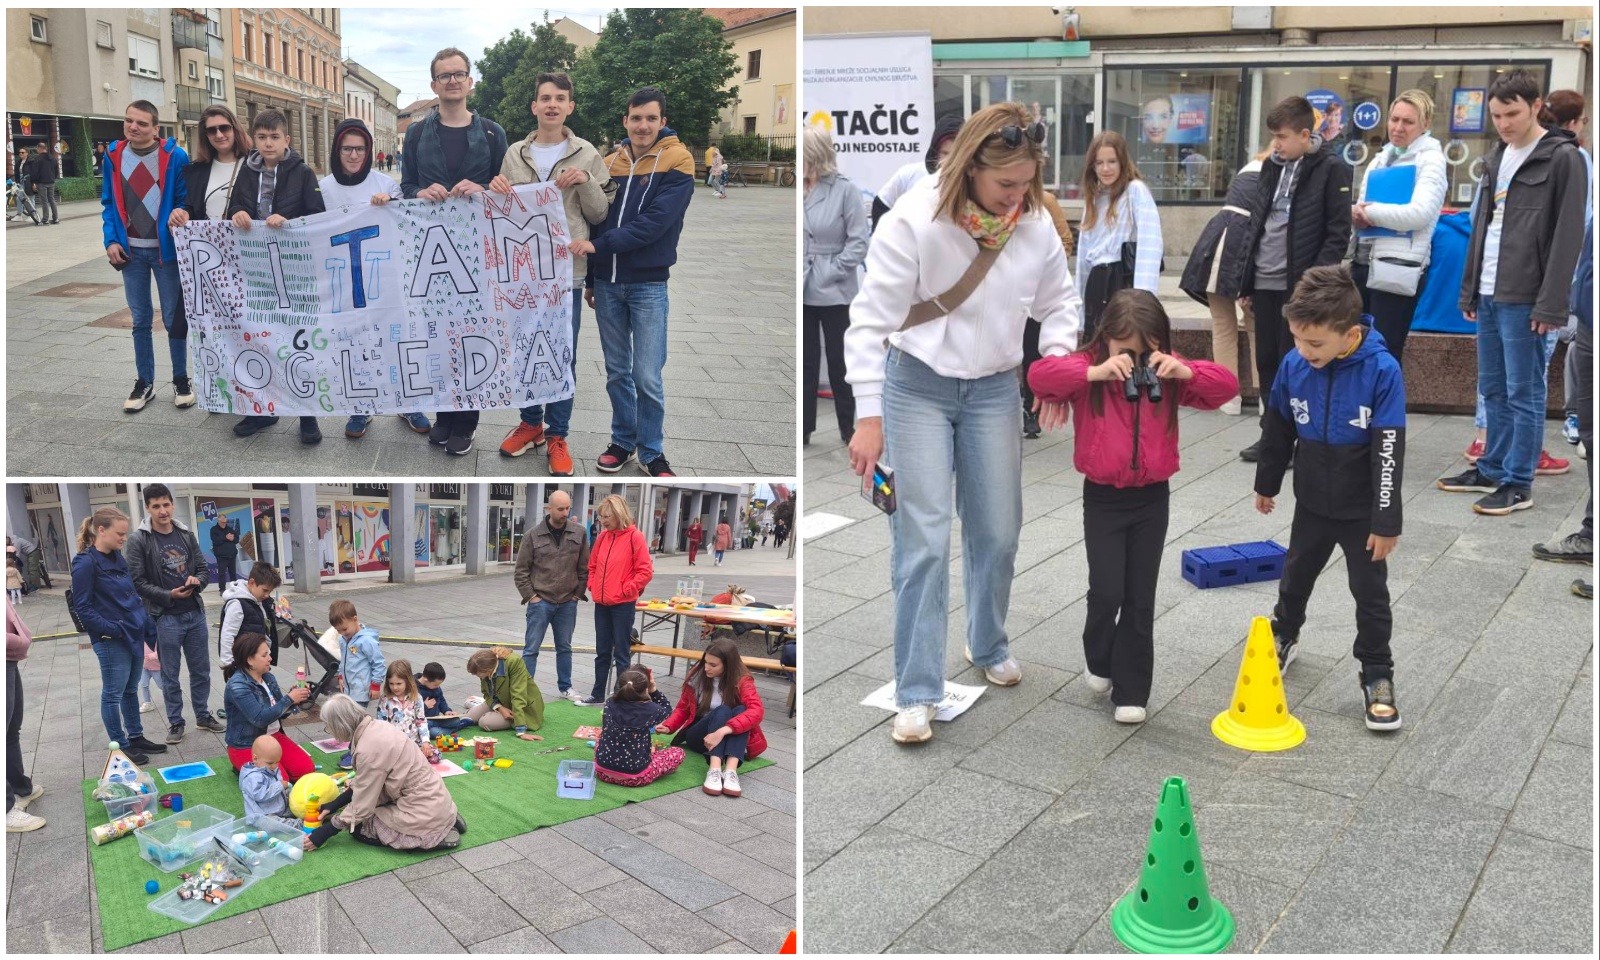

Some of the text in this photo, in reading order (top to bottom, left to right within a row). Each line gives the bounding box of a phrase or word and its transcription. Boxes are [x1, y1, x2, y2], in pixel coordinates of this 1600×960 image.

[1357, 111, 1378, 121] 1+1
[833, 143, 920, 153] OJI NEDOSTAJE
[1378, 429, 1396, 508] PlayStation
